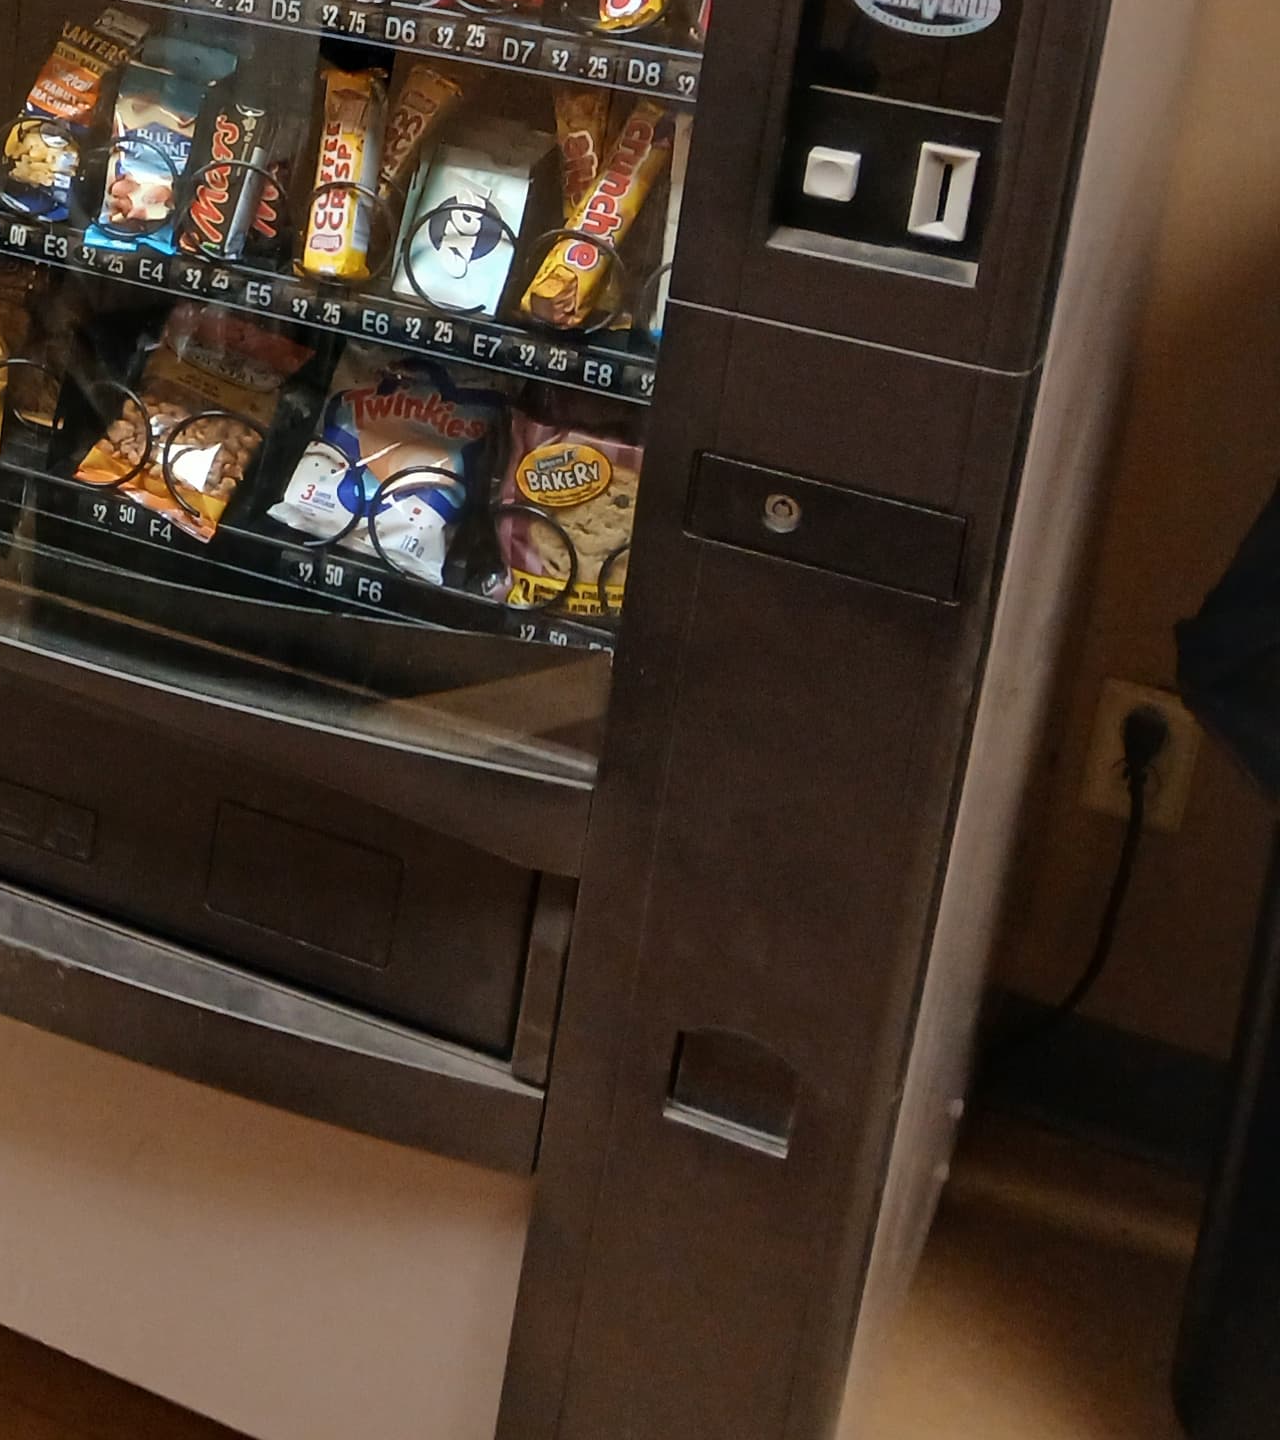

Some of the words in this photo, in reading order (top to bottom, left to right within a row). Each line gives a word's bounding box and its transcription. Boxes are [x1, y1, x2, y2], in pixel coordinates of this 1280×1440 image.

[385, 17, 416, 44] D6
[502, 37, 535, 64] D7
[628, 59, 660, 86] D8
[191, 114, 239, 243] Mars
[44, 234, 68, 258] E3
[139, 259, 164, 282] E4
[246, 281, 271, 306] E5
[361, 309, 390, 336] E6
[474, 333, 502, 360] E7
[583, 360, 612, 387] E8
[344, 386, 486, 439] Twinkies
[525, 462, 600, 492] BAKERY
[150, 519, 172, 542] F4
[357, 578, 382, 603] F6
